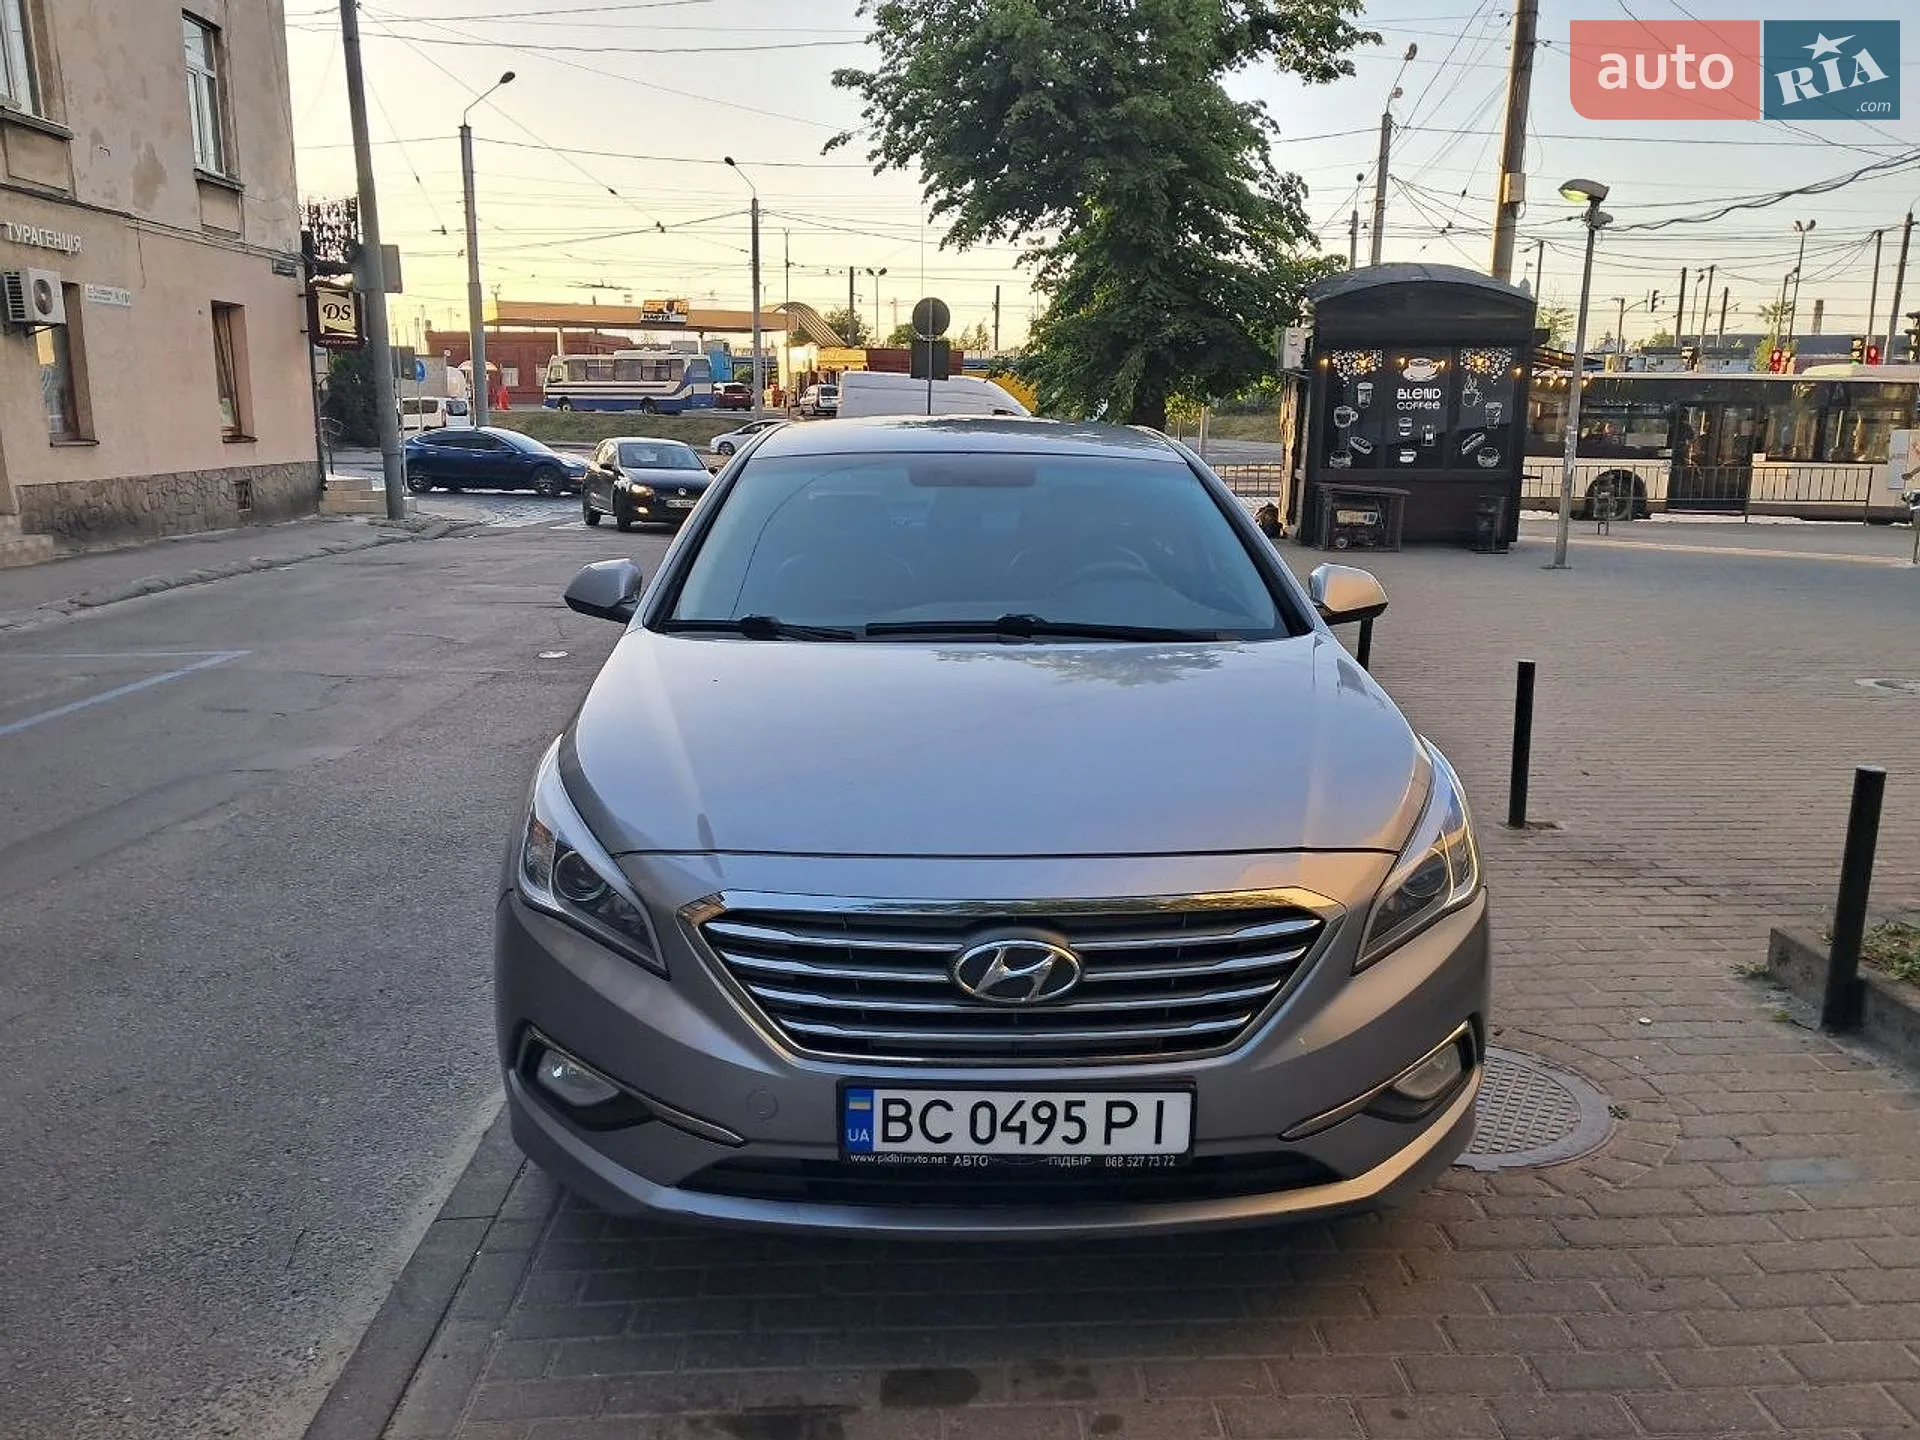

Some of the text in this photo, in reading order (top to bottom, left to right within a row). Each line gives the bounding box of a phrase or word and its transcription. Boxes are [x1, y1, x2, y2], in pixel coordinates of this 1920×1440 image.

[6, 222, 83, 256] ТУРАГЕНЦІЯ
[847, 1128, 870, 1143] UA
[881, 1097, 954, 1144] BC
[969, 1099, 1088, 1146] 0495
